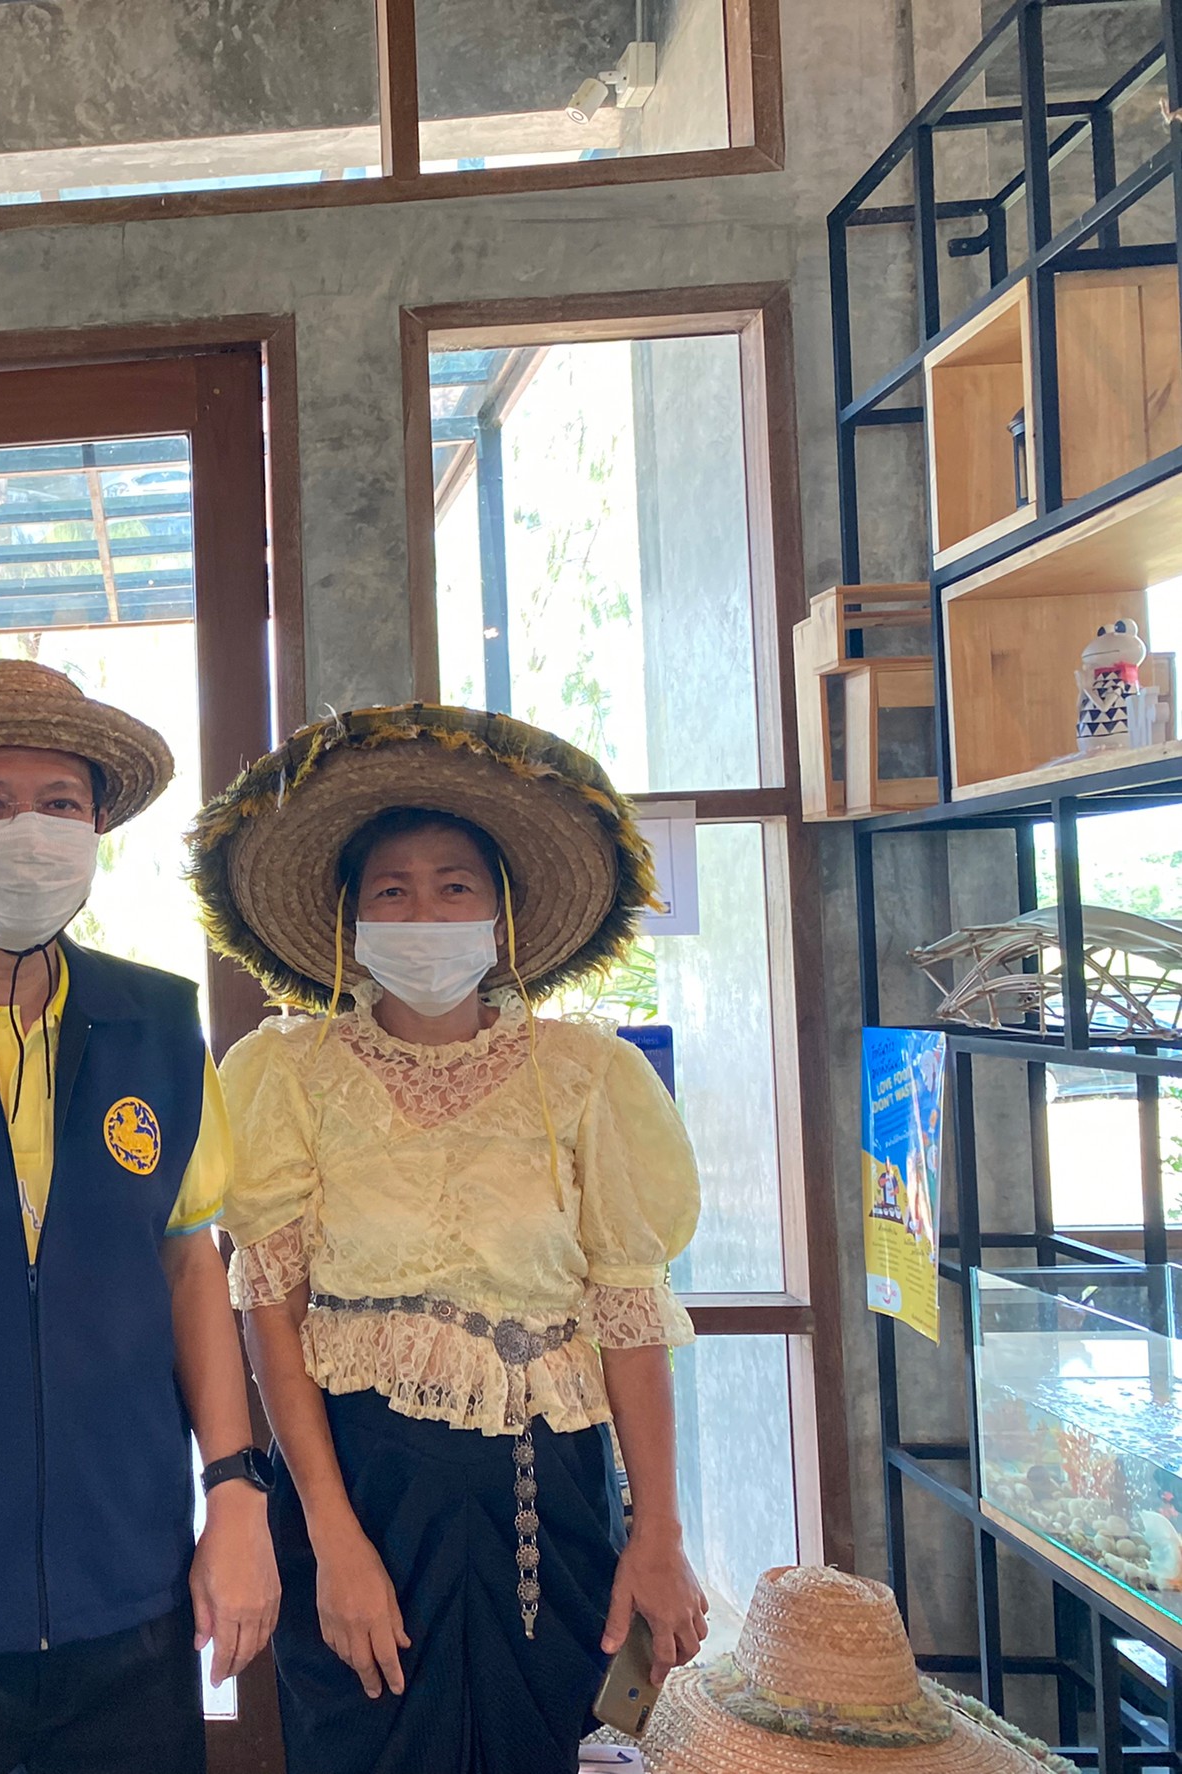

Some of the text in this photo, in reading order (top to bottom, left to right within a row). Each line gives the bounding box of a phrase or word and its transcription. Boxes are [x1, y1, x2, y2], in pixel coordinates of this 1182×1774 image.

[872, 1079, 918, 1114] DON'T WAST
[876, 1076, 893, 1096] LOVE
